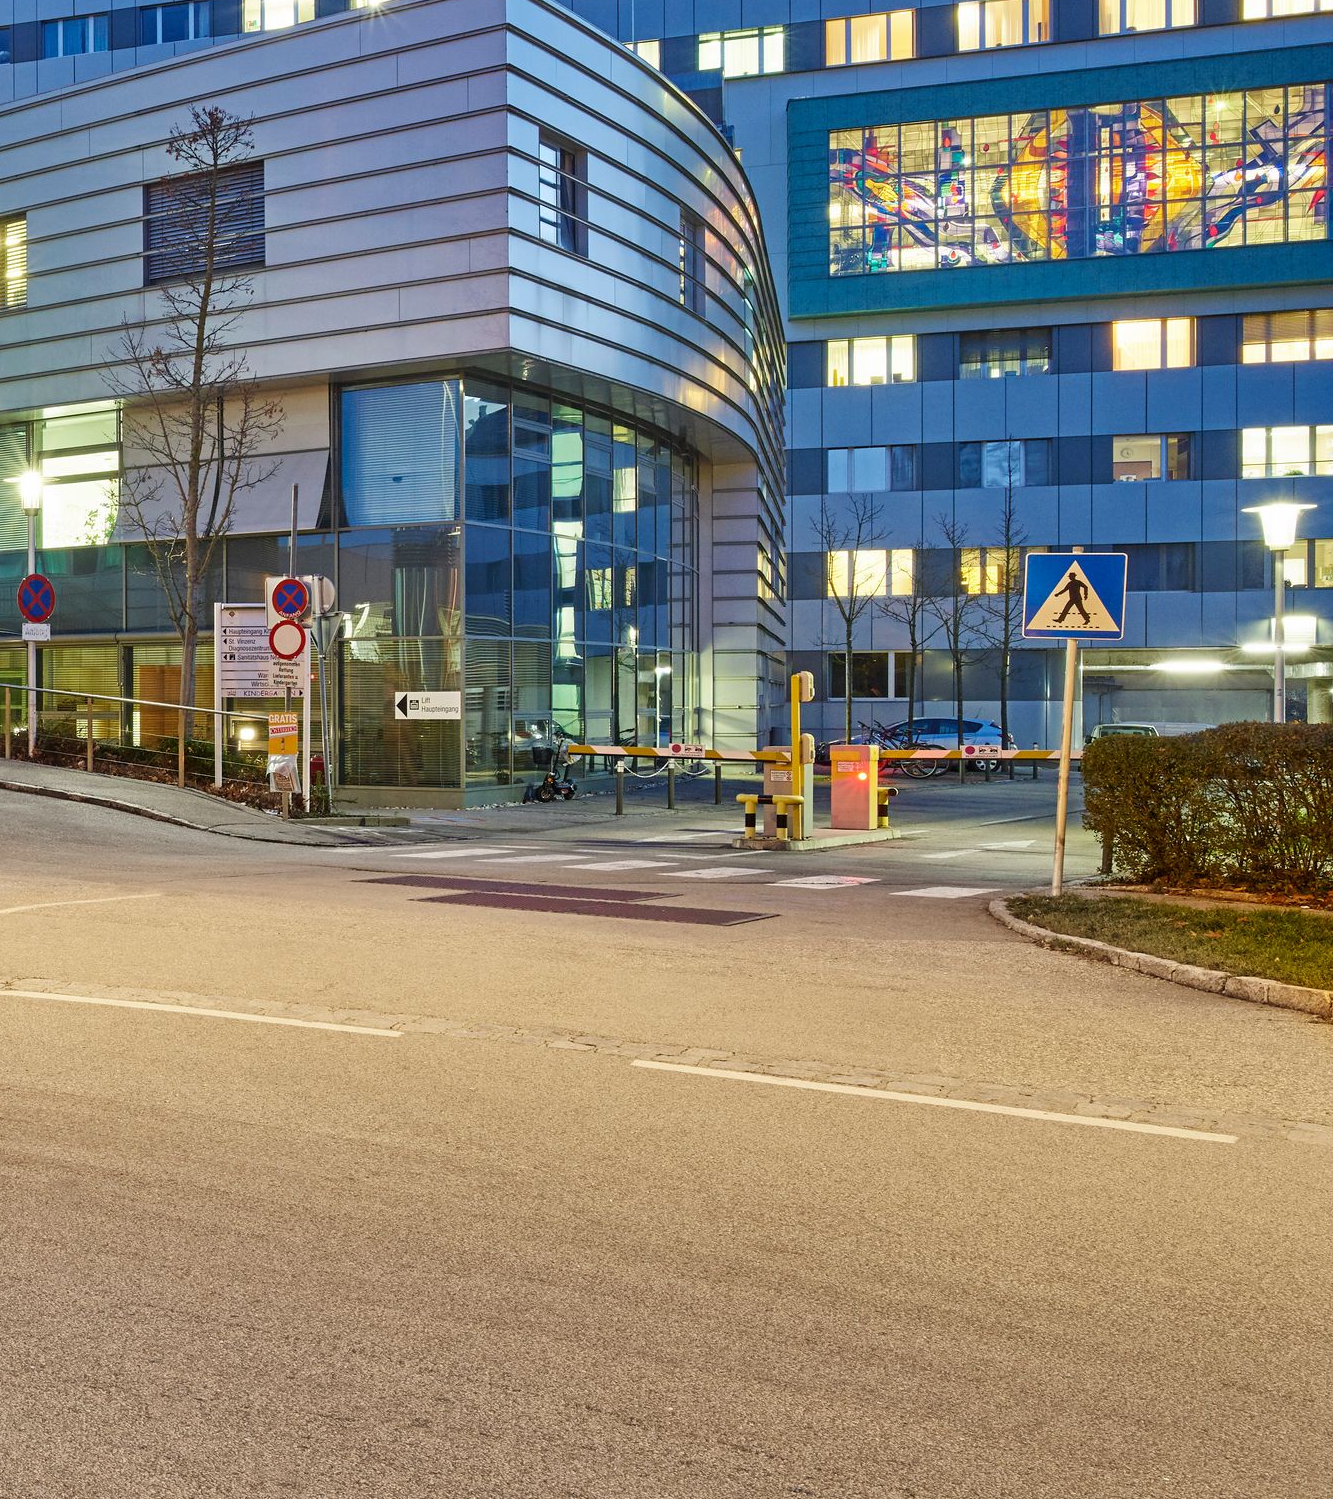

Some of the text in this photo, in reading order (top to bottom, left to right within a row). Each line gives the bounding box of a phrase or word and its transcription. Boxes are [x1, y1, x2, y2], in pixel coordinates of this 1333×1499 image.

[228, 628, 263, 636] Haupteingang
[421, 706, 459, 714] Haupteingang
[268, 713, 298, 724] GRATIS
